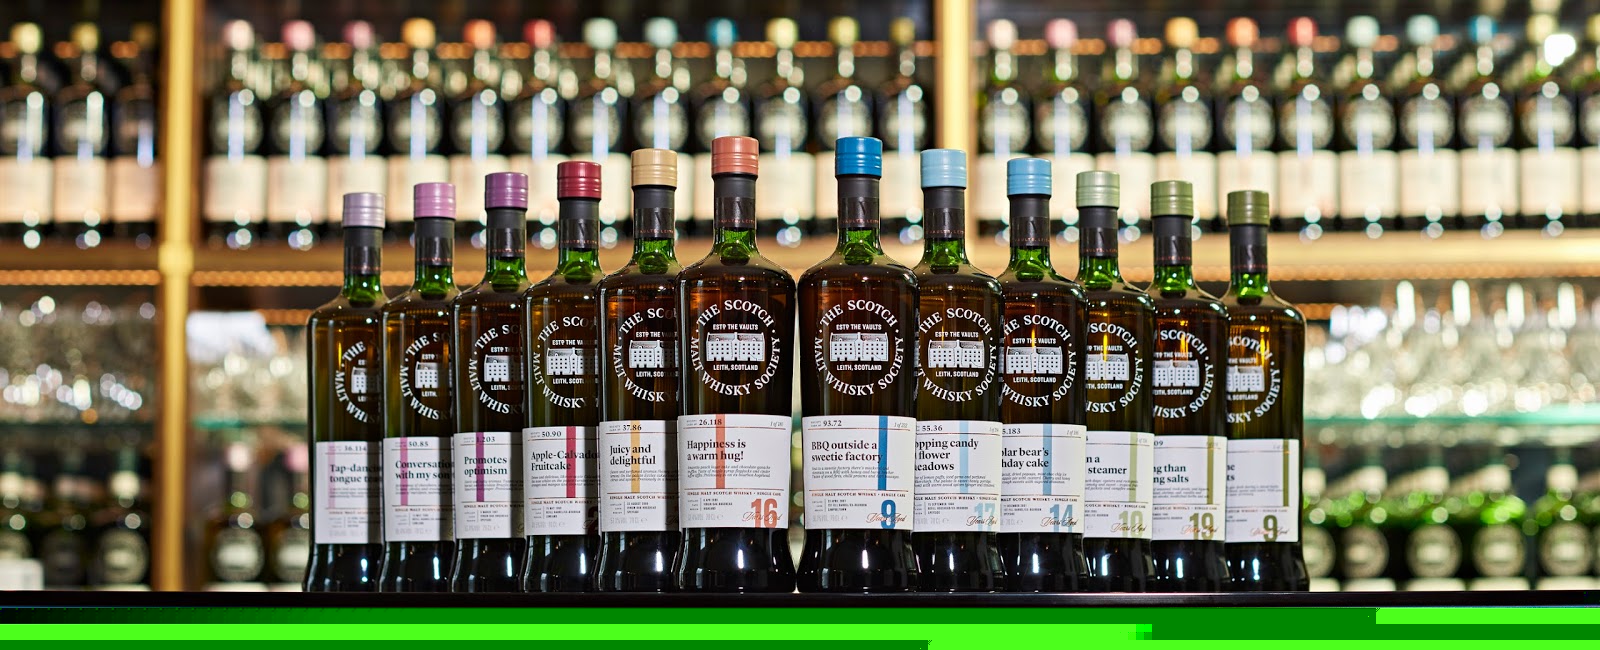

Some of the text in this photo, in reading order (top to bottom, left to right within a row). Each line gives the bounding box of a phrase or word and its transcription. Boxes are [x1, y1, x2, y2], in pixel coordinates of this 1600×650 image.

[619, 312, 644, 334] THE
[696, 299, 775, 328] THE SCOTCH
[820, 299, 898, 327] THE SCOTCH
[918, 307, 993, 335] THE SCOTCH
[474, 327, 499, 349] THE
[537, 320, 560, 342] THE
[1023, 314, 1071, 341] SCOTCH
[1089, 322, 1138, 348] SCOTCH
[341, 340, 366, 362] THE
[405, 335, 430, 356] THE
[1160, 329, 1208, 355] SCOTCH
[532, 352, 545, 385] MALT
[613, 344, 627, 378] MALT
[690, 336, 781, 396] MALT WHISKY SOCIETY
[814, 336, 828, 372] MALT
[825, 371, 875, 396] WHISKY
[877, 336, 904, 390] SOCIETY
[923, 344, 997, 402] WHISKY SOCIETY
[334, 370, 349, 402] MALT
[399, 365, 413, 397] MALT
[468, 358, 482, 391] MALT
[1002, 350, 1077, 407] WHISKY SOCIETY
[1119, 357, 1144, 407] SOCIETY
[1189, 363, 1215, 413] SOCIETY
[1254, 368, 1281, 418] SOCIETY
[610, 444, 651, 456] Juicy and
[687, 439, 747, 451] Happiness is
[720, 451, 744, 462] hug!
[811, 440, 877, 451] BBQ outside a
[811, 451, 883, 463] sweetie factory
[918, 450, 950, 460] flower
[950, 438, 979, 450] candy
[1019, 447, 1049, 457] bear's
[464, 456, 508, 465] Promotes
[464, 466, 508, 477] optimism
[531, 461, 571, 471] Fruitcake
[610, 455, 656, 467] delightful
[1025, 459, 1049, 468] cake
[1087, 466, 1128, 475] steamer
[1164, 463, 1187, 472] than
[329, 475, 362, 484] tongue
[395, 470, 415, 479] with
[416, 472, 432, 481] my
[1166, 474, 1189, 483] salts
[751, 498, 778, 528] 16
[881, 499, 896, 529] 9
[974, 503, 996, 532] 17
[1049, 503, 1073, 533] 14
[1189, 512, 1214, 540] 19
[1263, 514, 1278, 542] 9
